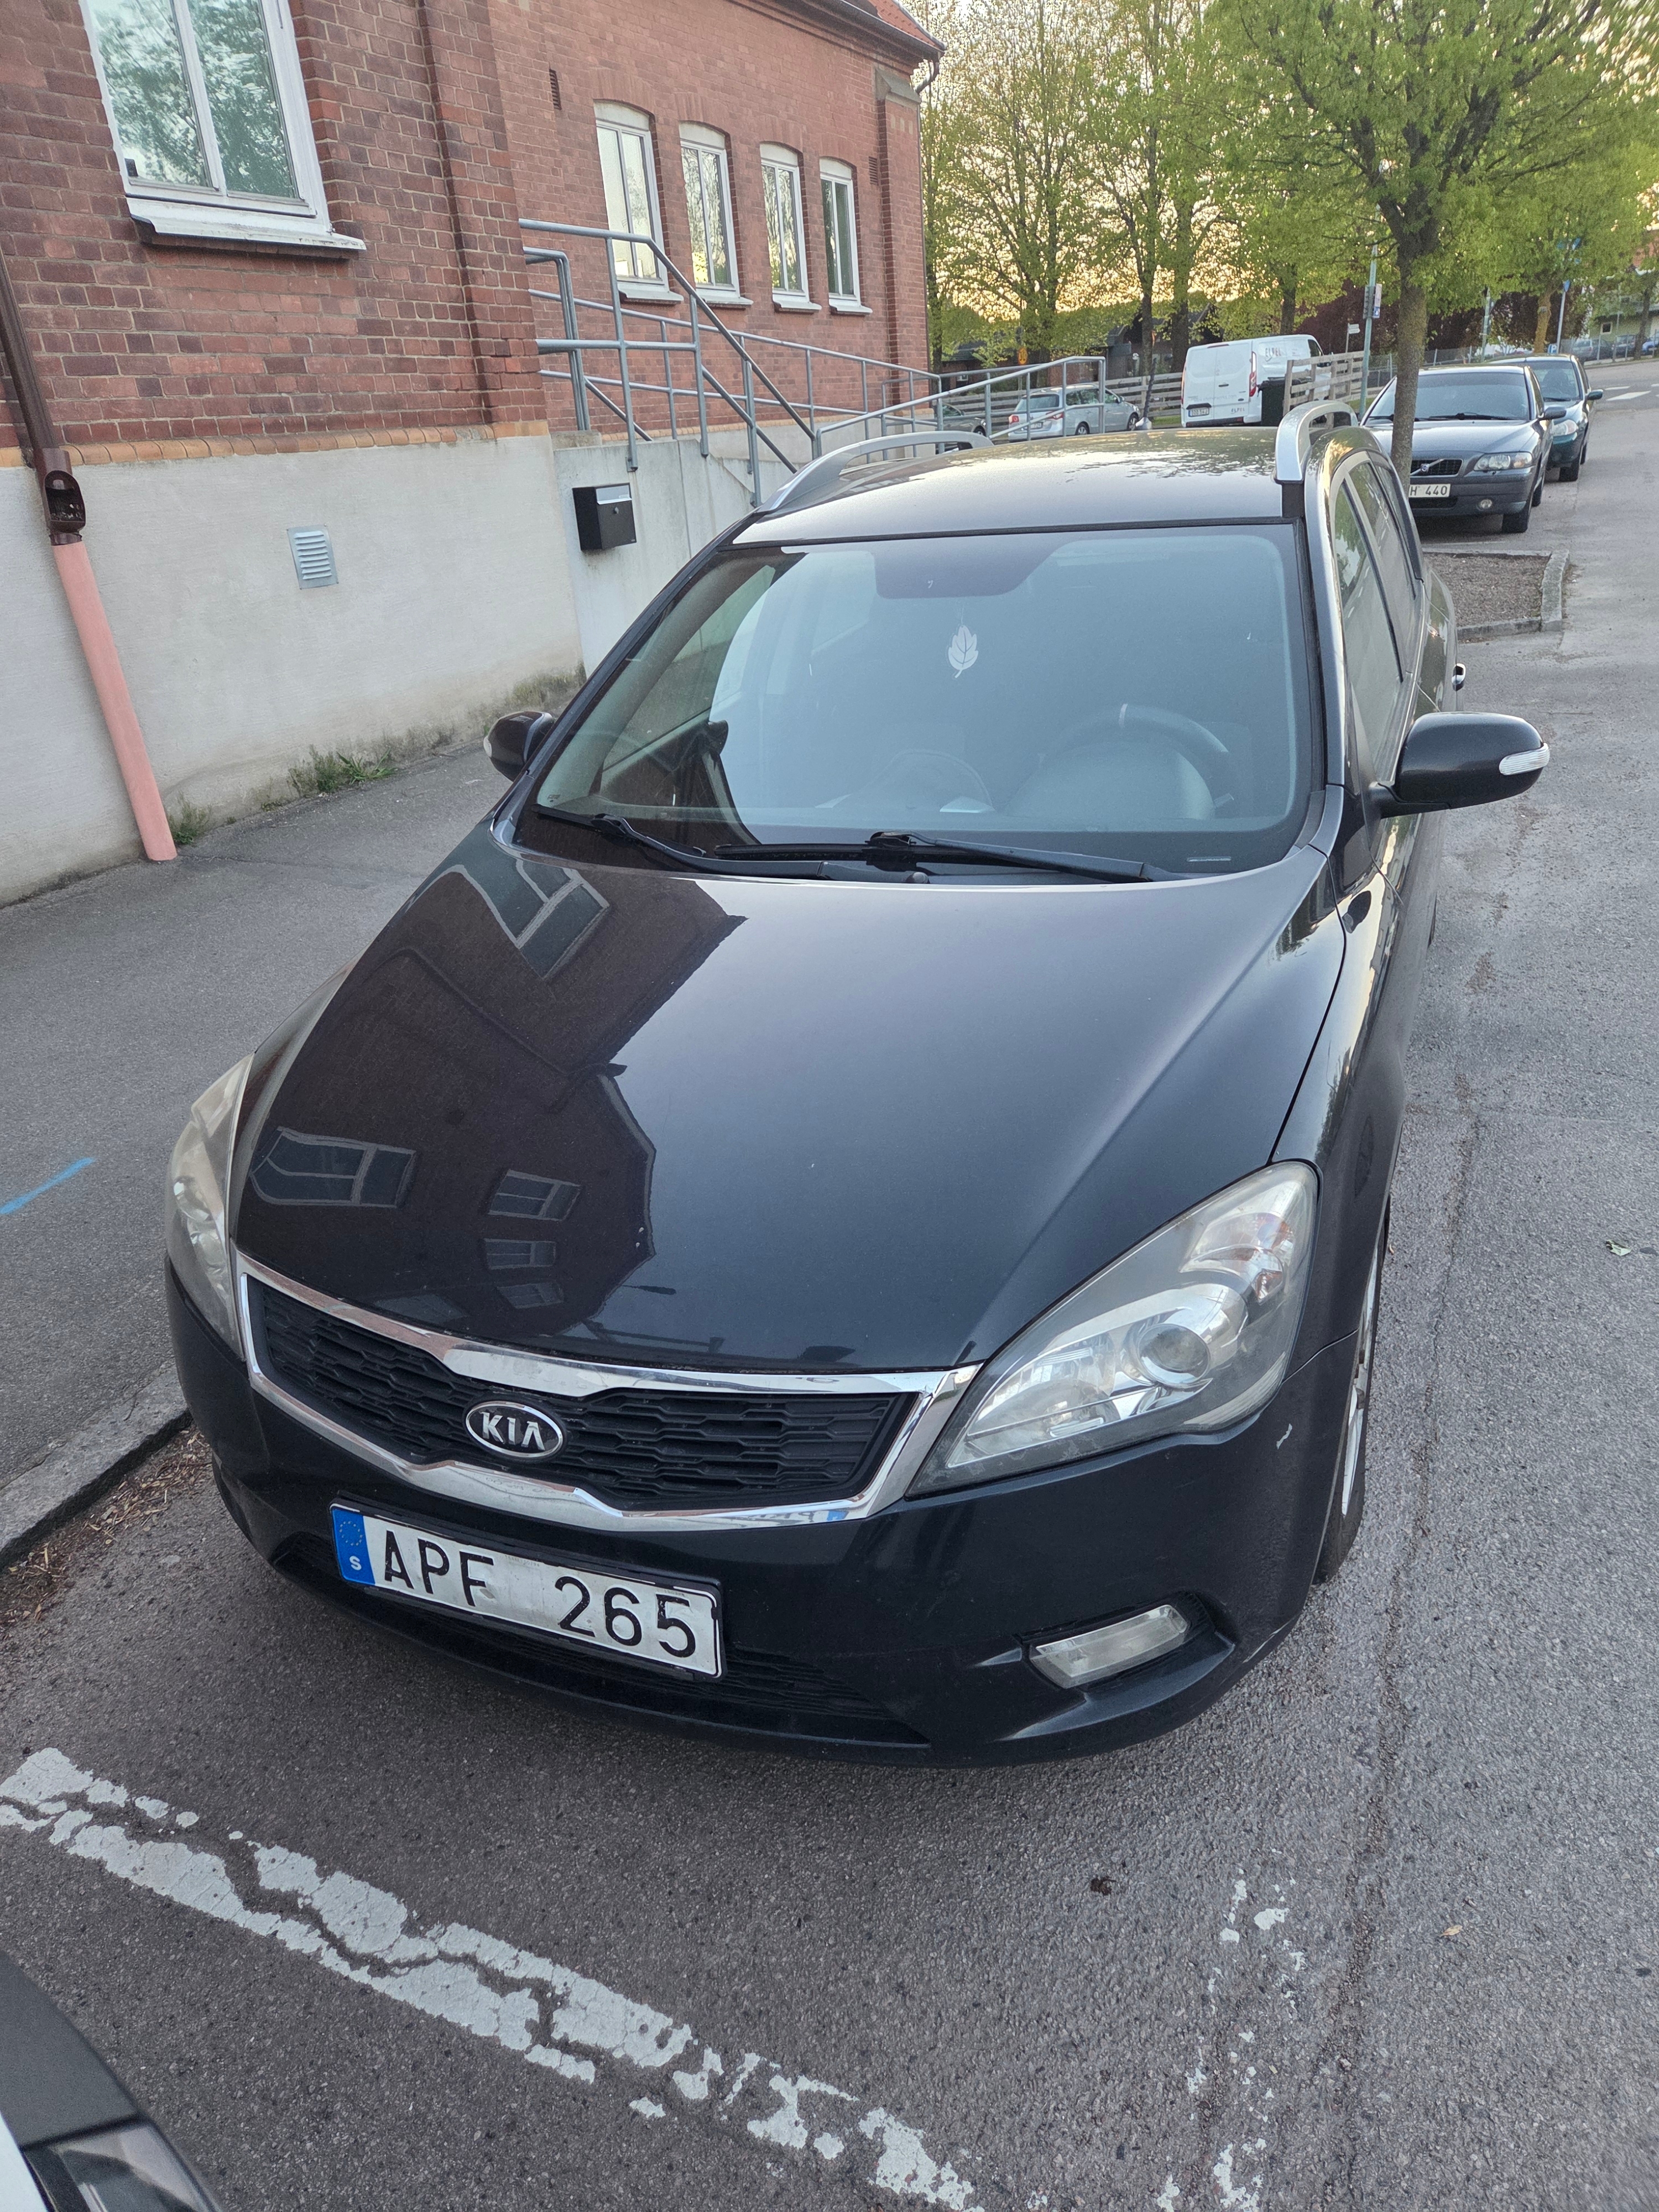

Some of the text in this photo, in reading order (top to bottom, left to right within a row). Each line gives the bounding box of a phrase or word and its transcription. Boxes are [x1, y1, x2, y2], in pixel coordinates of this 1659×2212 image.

[1410, 486, 1448, 496] H 440
[479, 1411, 545, 1451] KIA
[349, 1556, 362, 1571] S
[384, 1530, 696, 1657] APF 265
